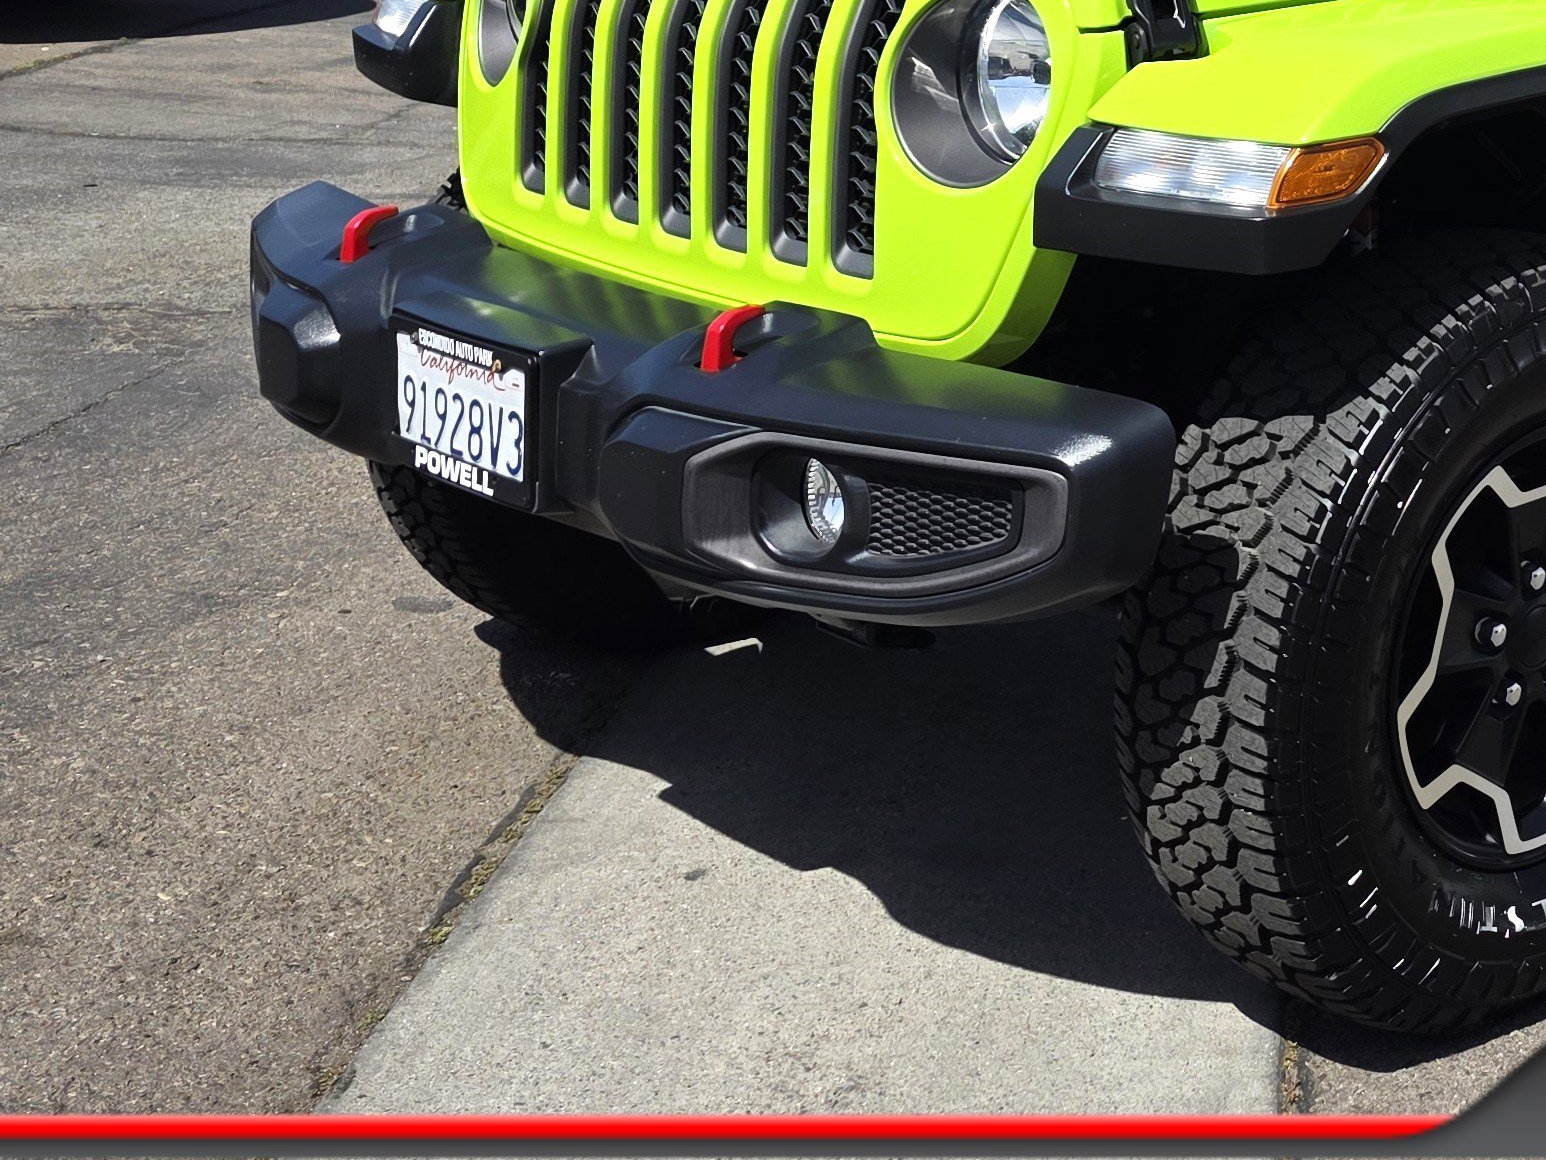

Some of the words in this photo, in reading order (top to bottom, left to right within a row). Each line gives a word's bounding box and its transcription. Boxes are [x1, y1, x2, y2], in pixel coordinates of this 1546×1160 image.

[455, 340, 474, 362] AUTO
[473, 346, 494, 367] PARK
[403, 374, 524, 476] 91928V3
[414, 444, 495, 497] POWELL
